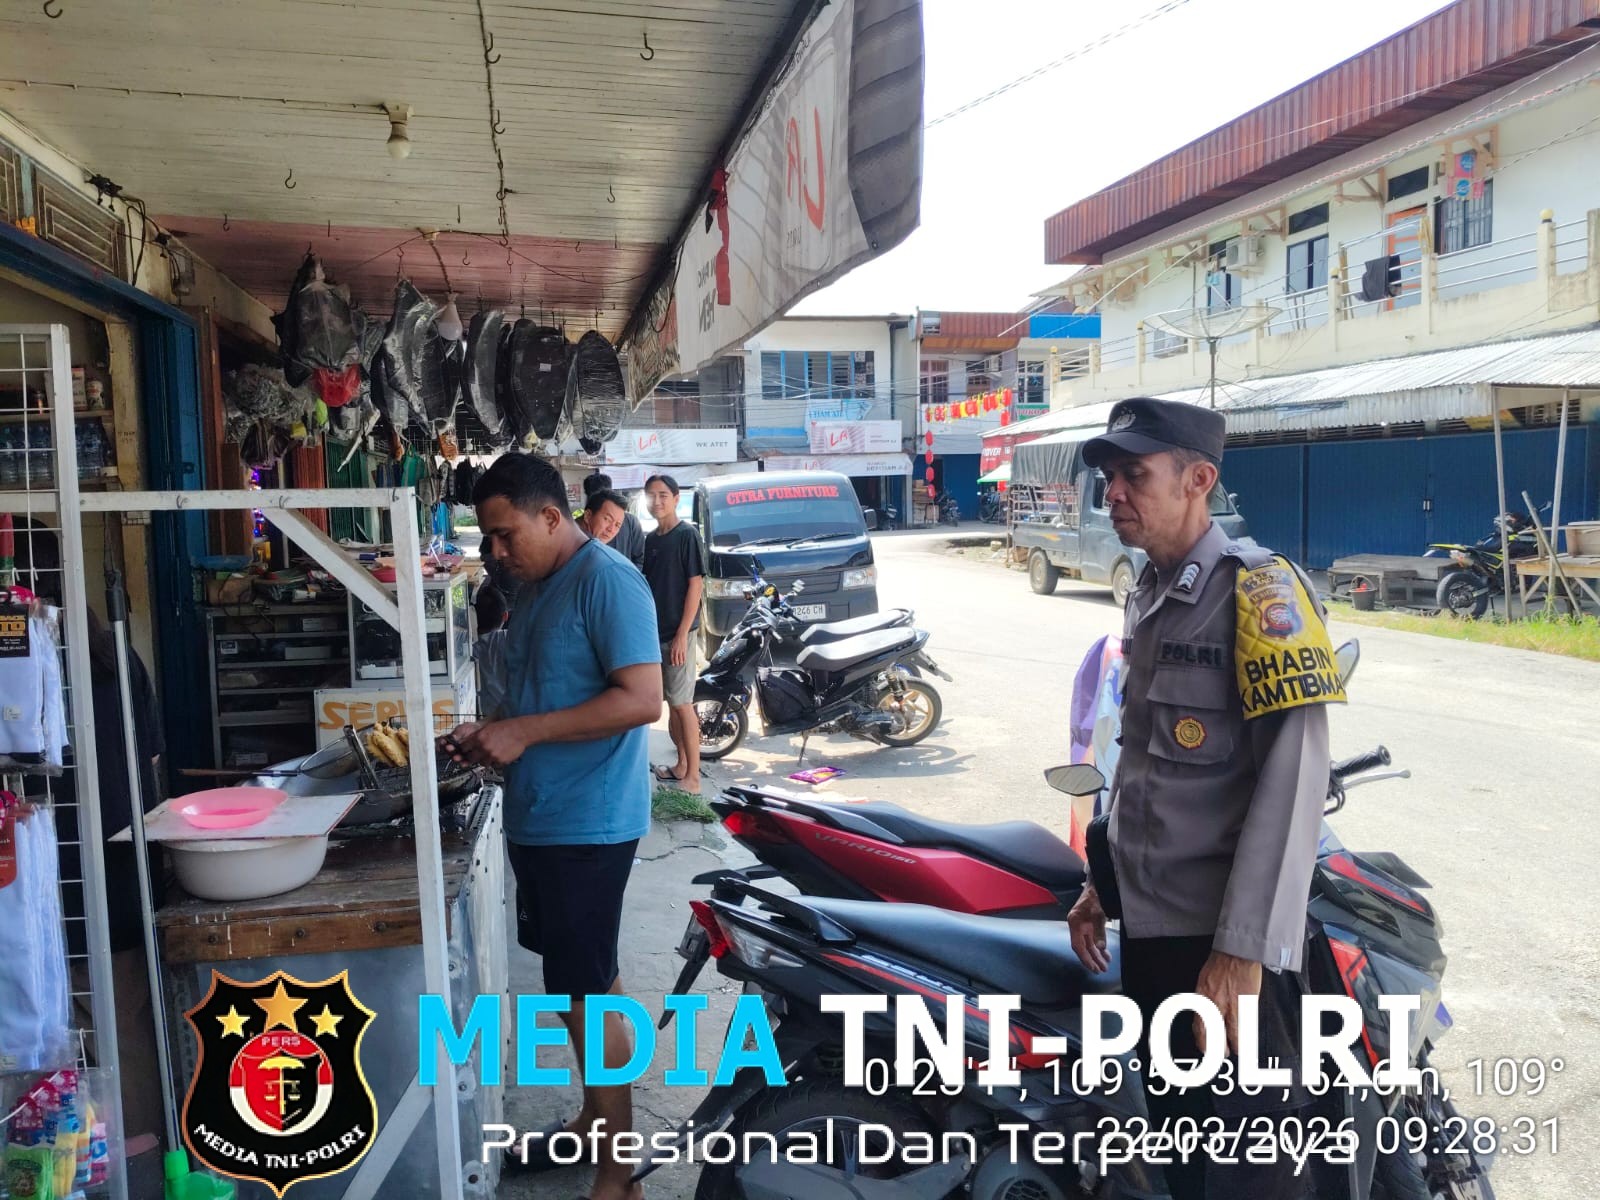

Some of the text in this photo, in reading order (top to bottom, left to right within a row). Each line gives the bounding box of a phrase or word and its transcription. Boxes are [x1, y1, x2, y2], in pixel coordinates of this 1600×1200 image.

[638, 433, 658, 452] LA
[829, 430, 848, 447] LA
[726, 485, 839, 505] CITRA FURNITURE
[1161, 642, 1223, 667] POLRI
[1244, 646, 1333, 684] BHABIN
